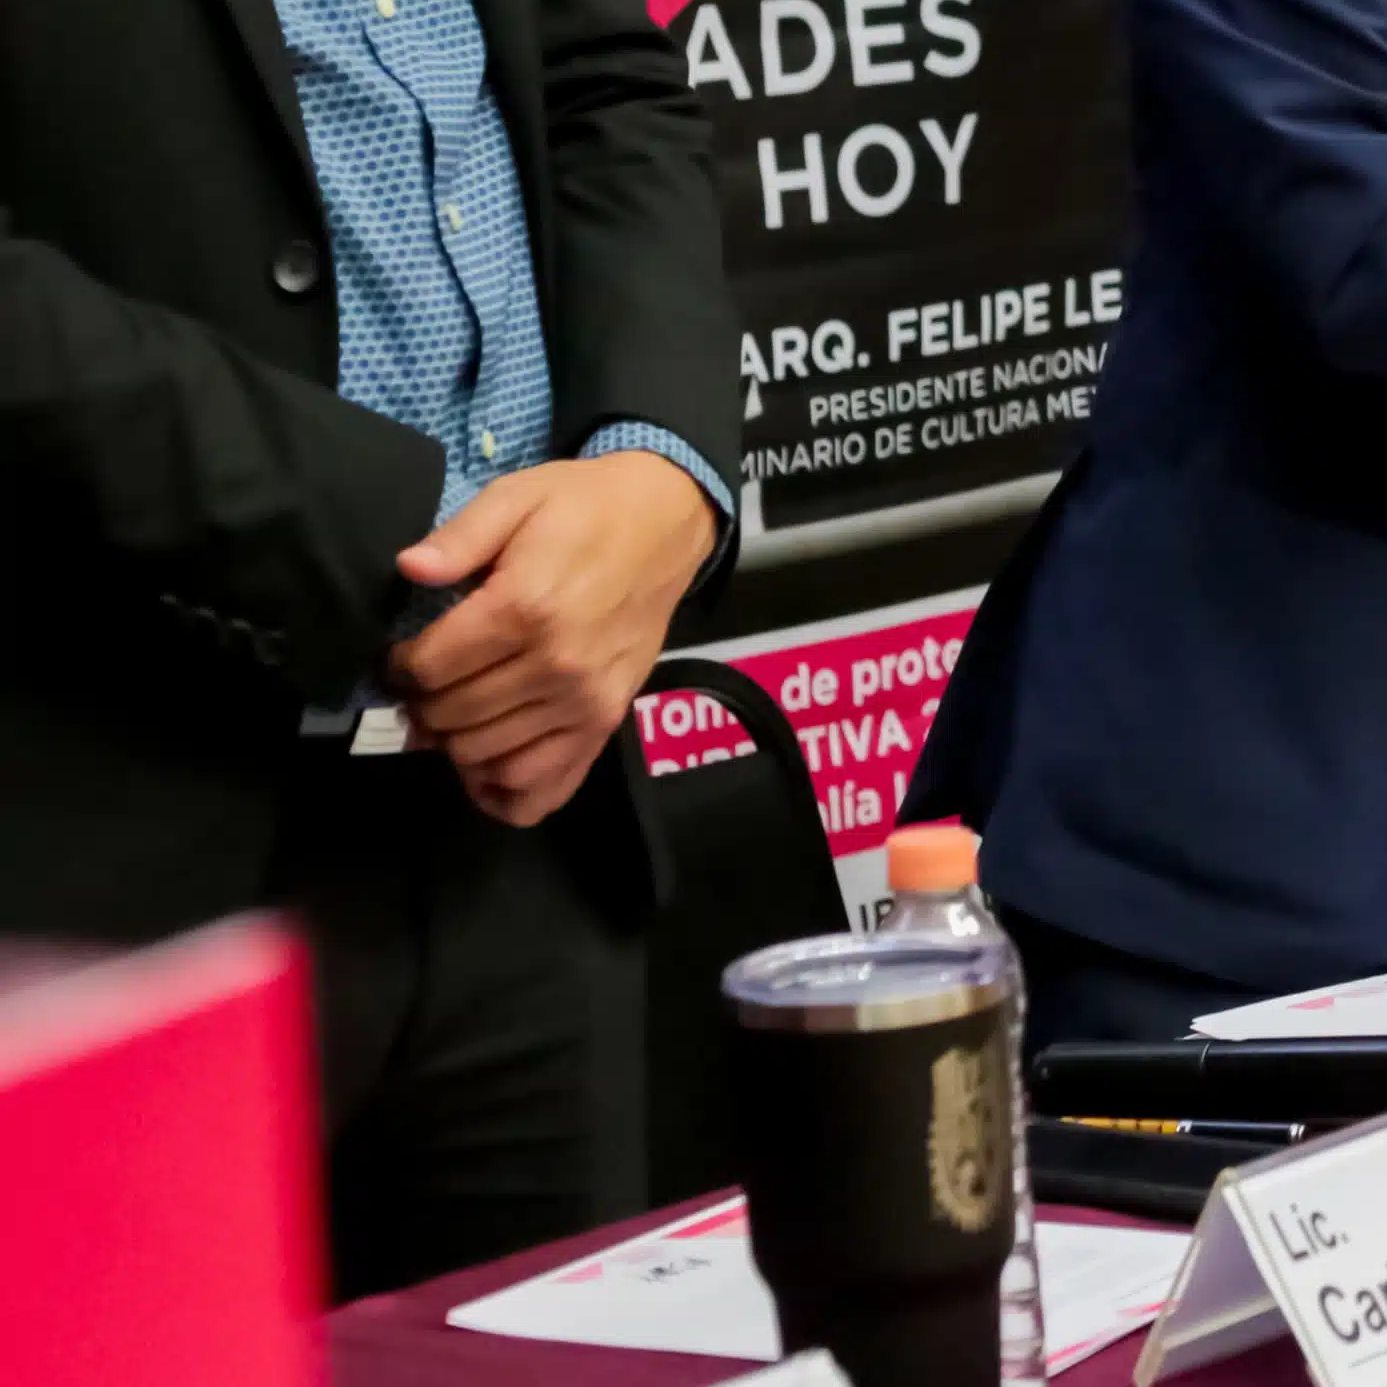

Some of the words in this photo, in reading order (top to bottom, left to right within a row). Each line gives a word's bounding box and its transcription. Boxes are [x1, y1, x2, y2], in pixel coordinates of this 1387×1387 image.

[757, 113, 978, 230] HOY
[740, 319, 871, 383] ARQ.
[887, 282, 1051, 363] FELIPE
[809, 367, 987, 427] PRESIDENTE
[874, 425, 913, 460] DE
[920, 399, 1040, 450] CULTURA
[780, 662, 838, 713] de
[1269, 1200, 1349, 1263] Lic.
